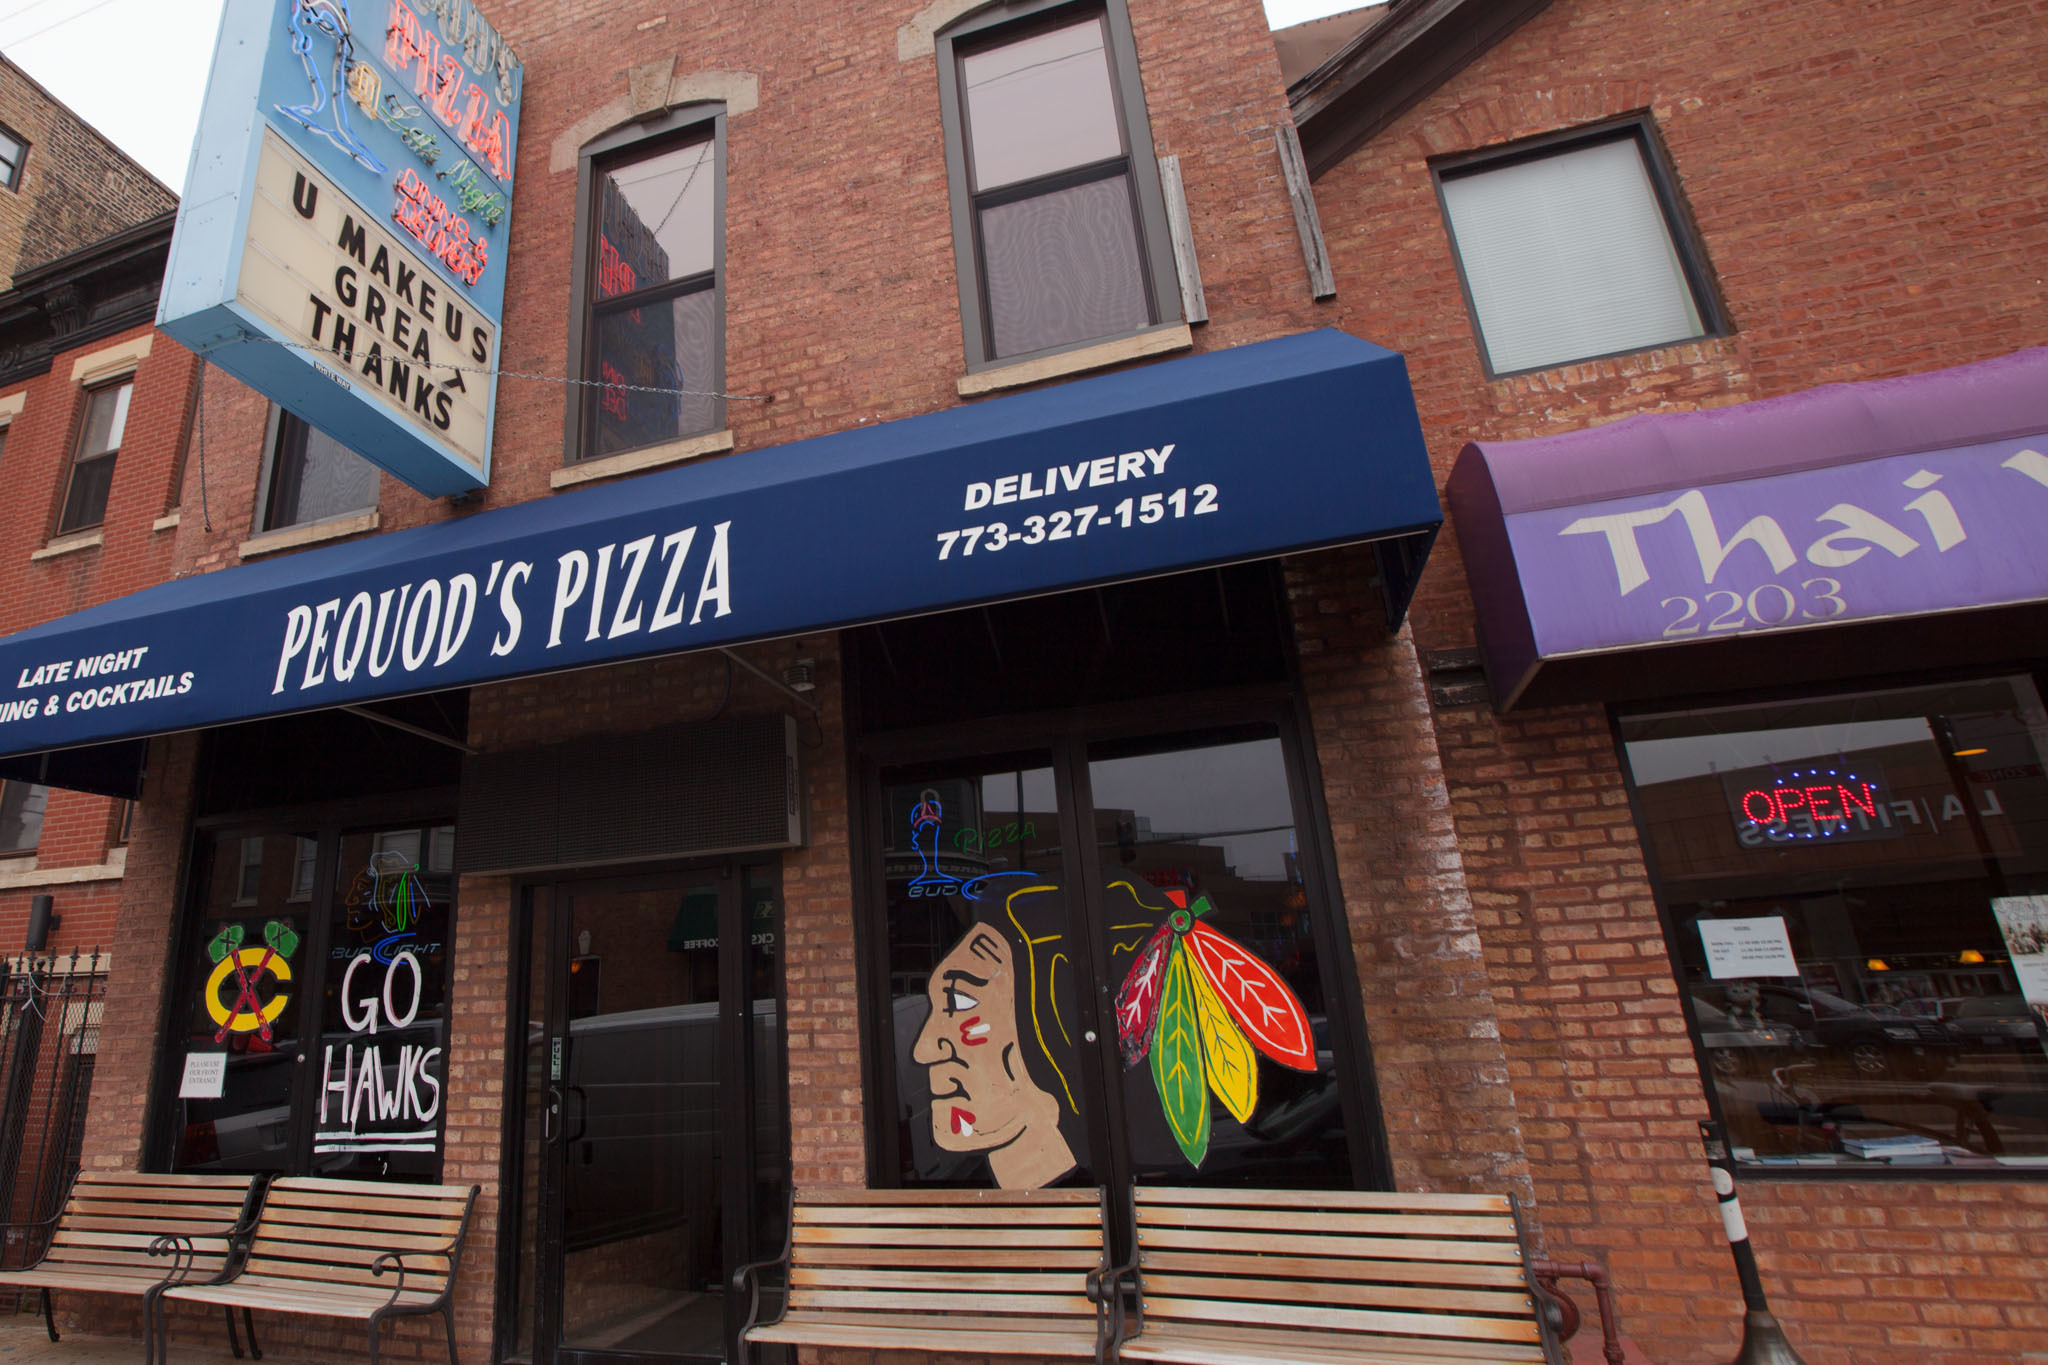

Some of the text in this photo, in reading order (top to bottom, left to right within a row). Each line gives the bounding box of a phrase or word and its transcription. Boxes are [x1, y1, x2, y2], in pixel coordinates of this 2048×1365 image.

[384, 0, 511, 181] PIZZA
[292, 171, 318, 220] U
[392, 168, 470, 244] DINING
[392, 196, 485, 286] DELIVERY
[308, 293, 453, 430] THANKS
[964, 443, 1176, 511] DELIVERY
[937, 483, 1219, 560] 773-327-1512
[1557, 468, 1968, 597] Thai
[271, 520, 733, 696] PEQUOD'S PIZZA
[1660, 577, 1848, 638] 2203
[0, 671, 195, 723] ING & COCKTAILS
[17, 646, 149, 688] LATE NIGHT
[1742, 781, 1877, 825] OPEN
[908, 885, 959, 898] BUD
[331, 942, 441, 960] BUD LIGHT
[341, 951, 422, 1034] GO
[320, 1043, 442, 1125] HAWKS
[552, 1041, 561, 1066] PULL
